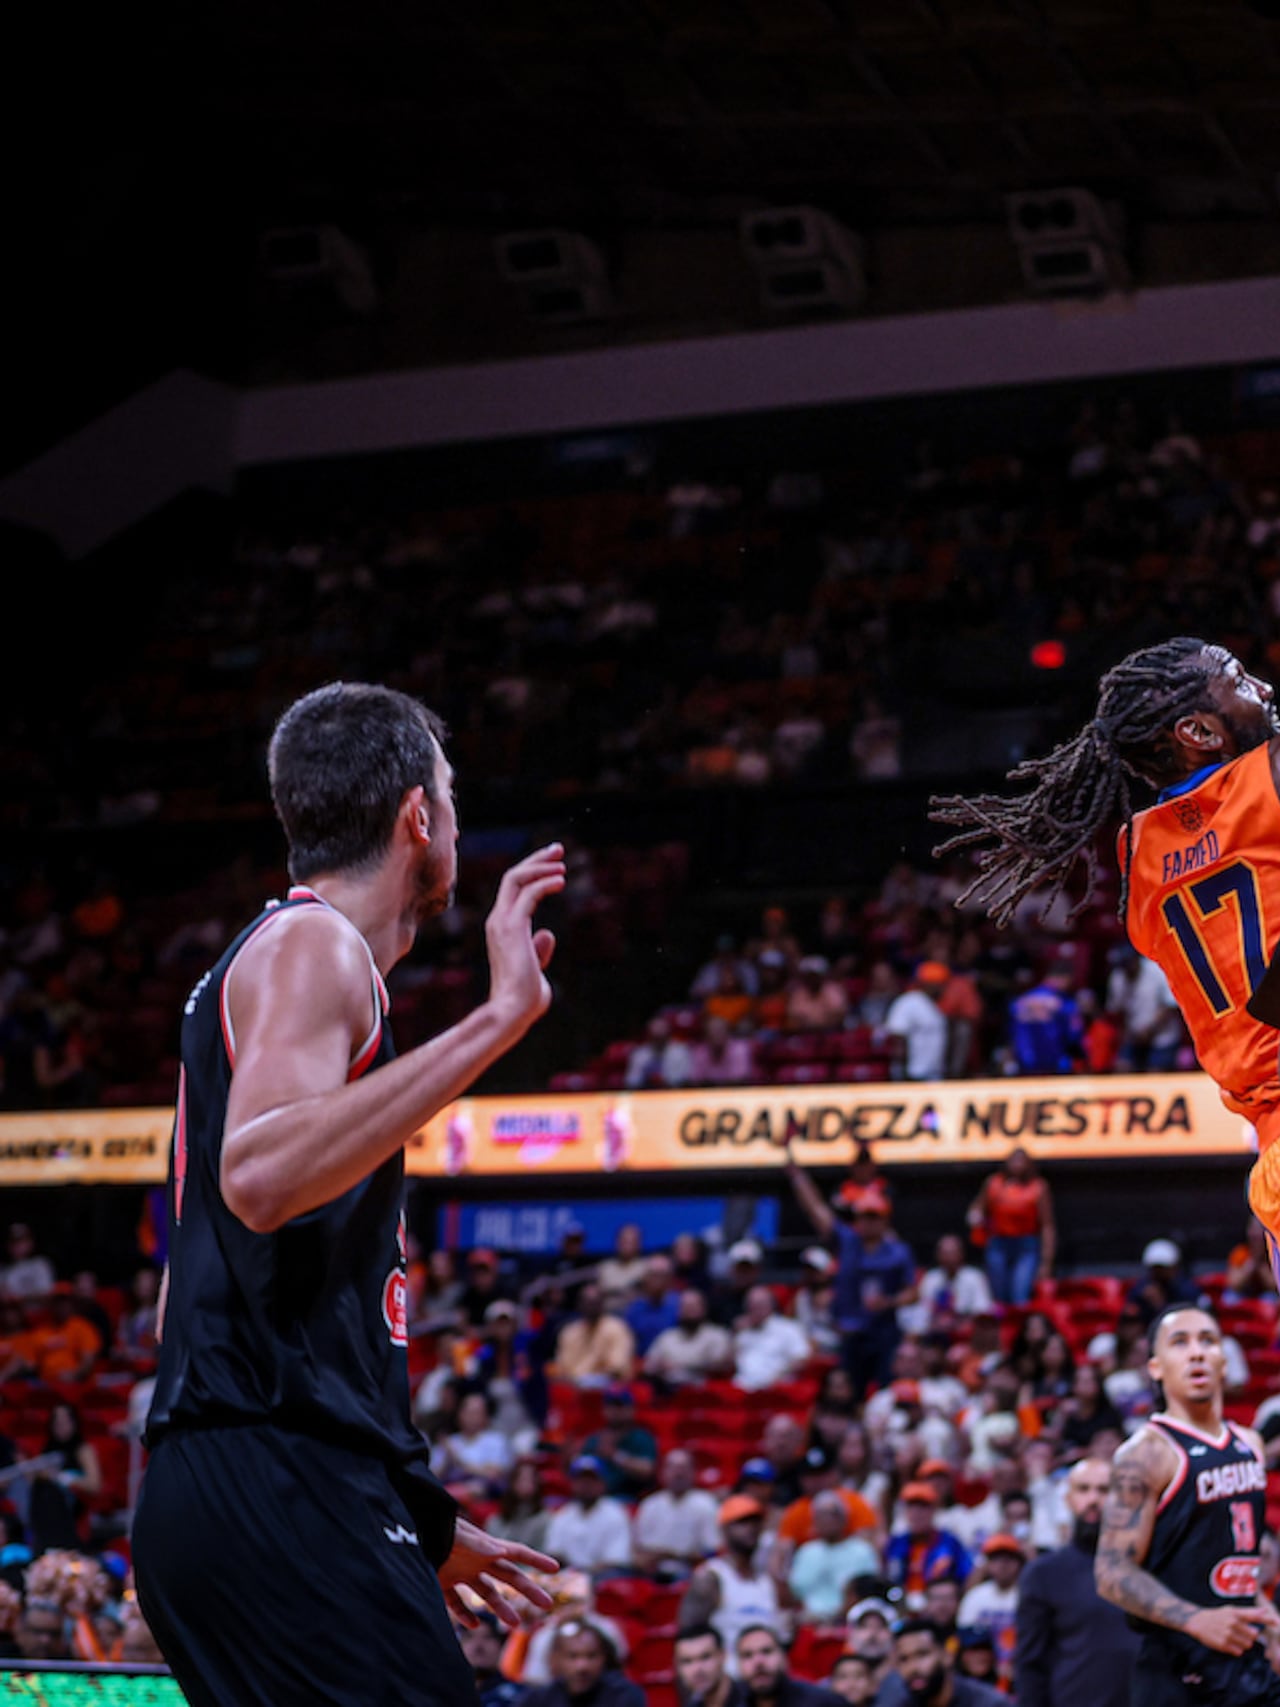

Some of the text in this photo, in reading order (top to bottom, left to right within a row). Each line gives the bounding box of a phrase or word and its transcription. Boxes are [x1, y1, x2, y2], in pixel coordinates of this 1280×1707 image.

[1159, 856, 1271, 1020] 17
[679, 1095, 1192, 1148] GRANDEZA NUESTRA
